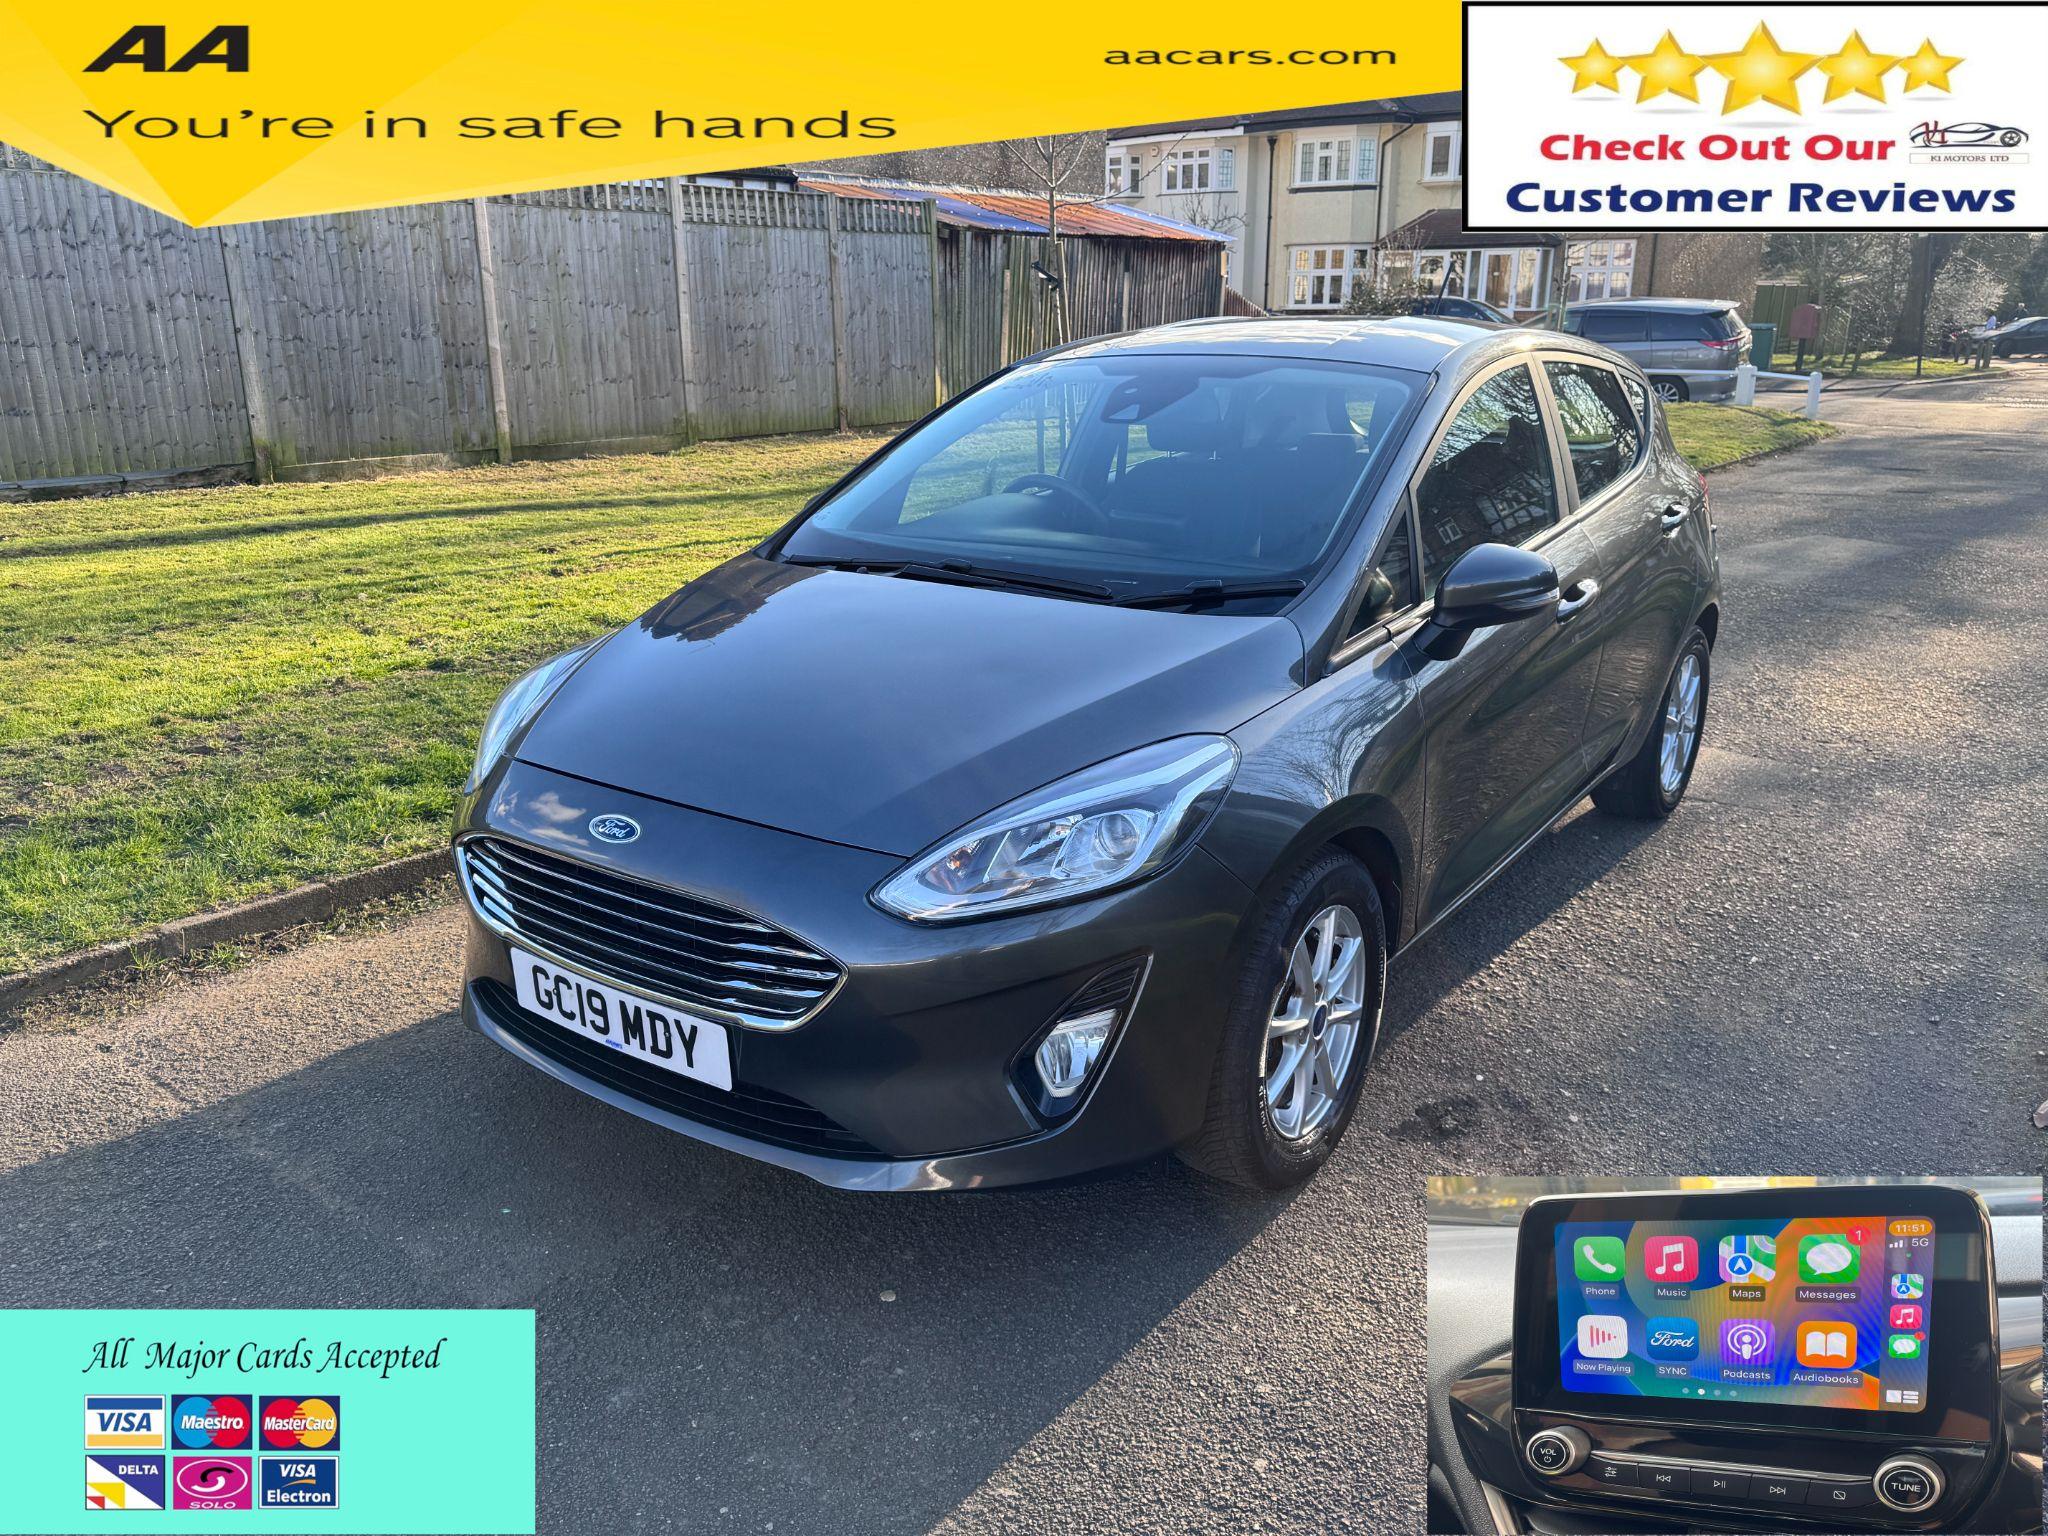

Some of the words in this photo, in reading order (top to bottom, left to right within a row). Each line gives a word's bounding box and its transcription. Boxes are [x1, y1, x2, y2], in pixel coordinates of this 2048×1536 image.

[599, 819, 630, 838] Ford
[532, 965, 610, 1036] GC19
[619, 999, 698, 1069] MDY
[1895, 1224, 1925, 1233] 11:51
[1911, 1237, 1929, 1248] 5G
[1585, 1287, 1616, 1296] Phone
[1657, 1288, 1687, 1297] Music
[1732, 1289, 1761, 1299] Maps
[1799, 1290, 1856, 1300] Messages
[1650, 1330, 1695, 1348] Ford
[1576, 1362, 1596, 1371] Now
[1598, 1364, 1631, 1374] Playing
[1658, 1366, 1687, 1376] SYNC
[1723, 1369, 1771, 1380] Podcasts
[1793, 1372, 1859, 1384] Audiobooks
[1539, 1447, 1557, 1457] VOL
[1891, 1482, 1921, 1494] TUNE
